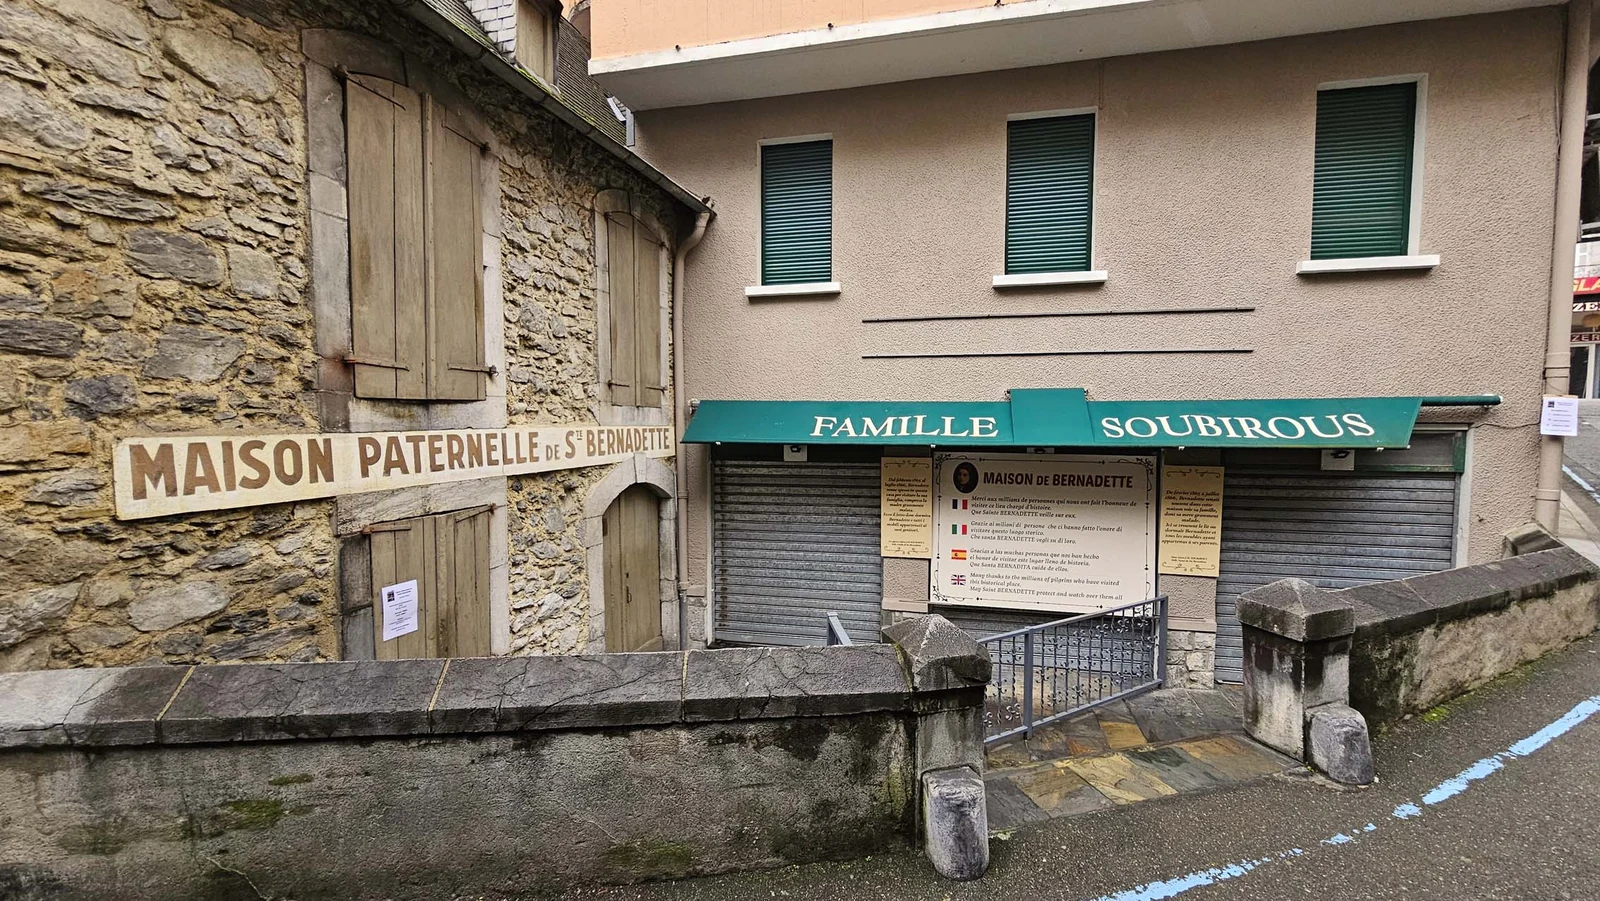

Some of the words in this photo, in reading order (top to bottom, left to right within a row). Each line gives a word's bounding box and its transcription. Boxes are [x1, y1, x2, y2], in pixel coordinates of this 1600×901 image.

[1572, 301, 1600, 312] ZE
[811, 416, 999, 438] FAMILLE
[1101, 412, 1376, 440] SOUBIROUS
[129, 438, 335, 501] MAISON
[357, 431, 540, 479] PATERNELLE
[546, 444, 560, 461] DE
[586, 427, 670, 457] BERNADETTE
[983, 472, 1033, 486] MAISON
[1036, 476, 1050, 486] DE
[1052, 473, 1134, 489] BERNADETTE
[1006, 503, 1024, 511] chargé
[1090, 499, 1101, 507] fait
[991, 527, 1008, 536] questo
[1009, 528, 1024, 536] luogo
[1081, 524, 1096, 533] fatto
[1036, 536, 1049, 544] vegli
[1029, 557, 1044, 565] lugar
[970, 571, 985, 580] Many
[1044, 576, 1052, 584] of
[1006, 580, 1021, 589] place.
[970, 585, 982, 594] May
[997, 587, 1036, 595] BERNADETTE
[1036, 589, 1056, 598] protect
